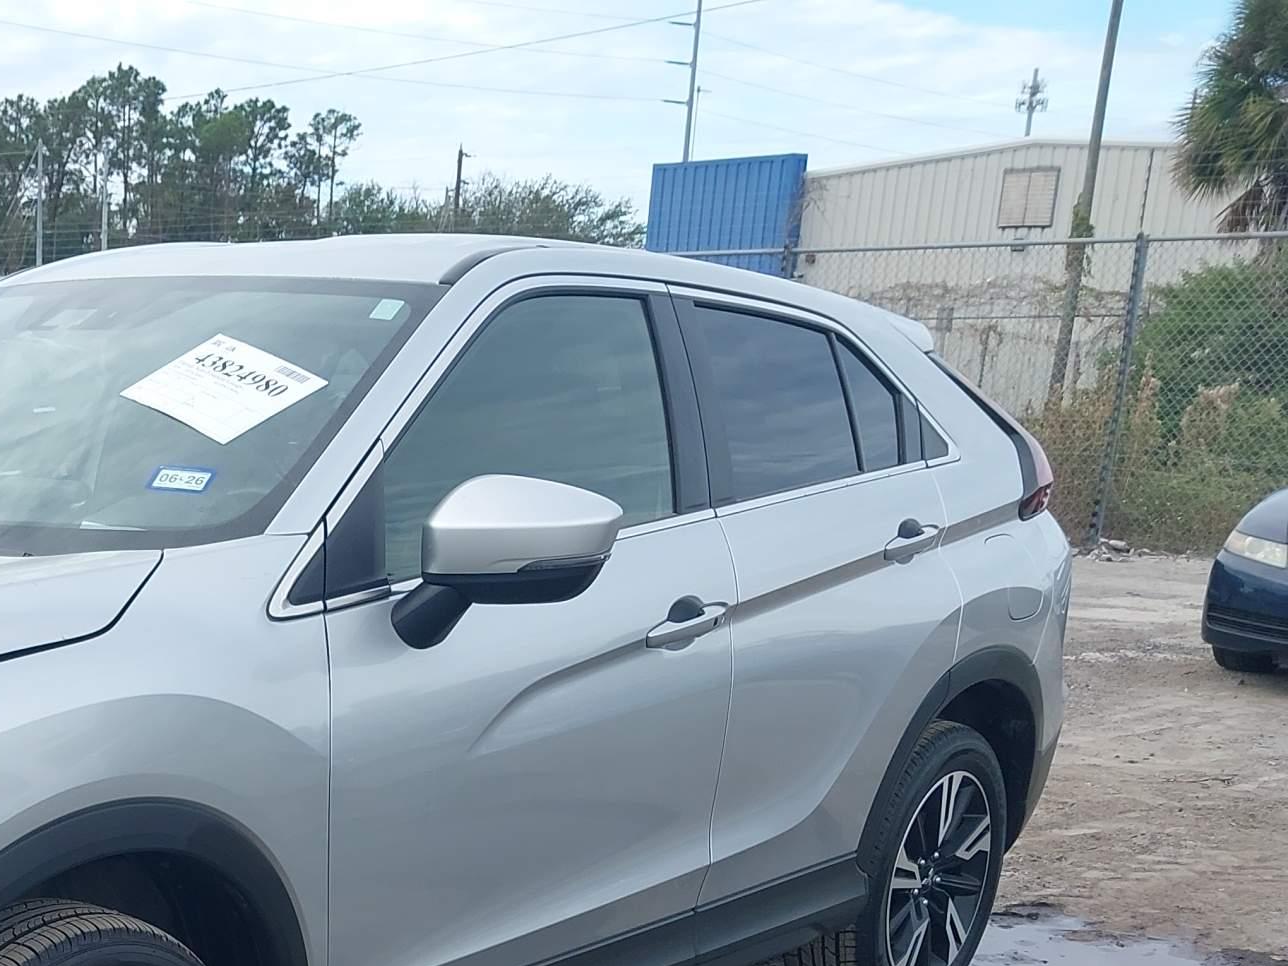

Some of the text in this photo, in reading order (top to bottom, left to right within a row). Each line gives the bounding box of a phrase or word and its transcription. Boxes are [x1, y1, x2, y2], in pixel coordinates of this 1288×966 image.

[195, 353, 289, 398] 43824980
[159, 473, 206, 486] 06 26
